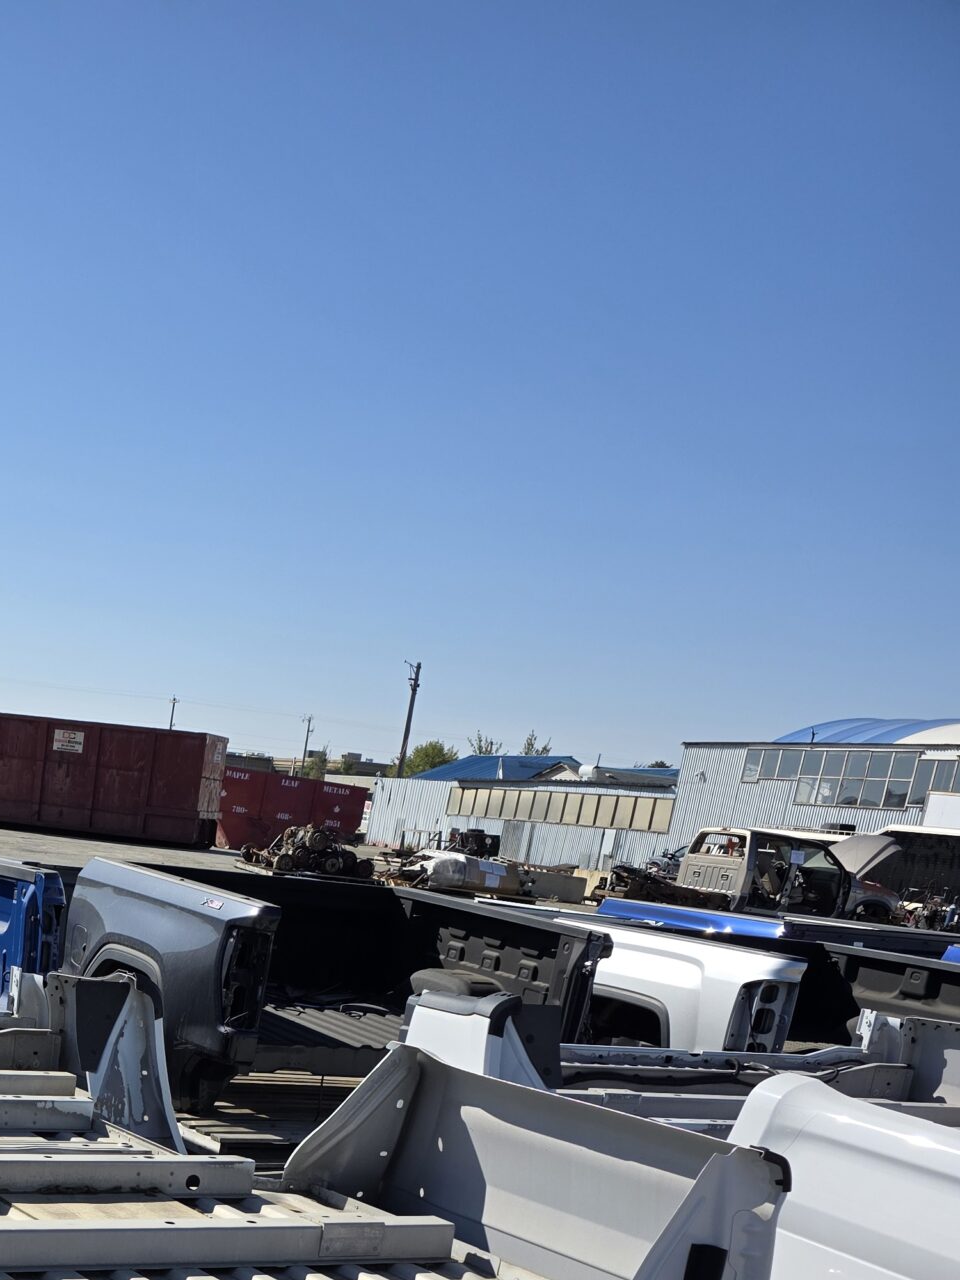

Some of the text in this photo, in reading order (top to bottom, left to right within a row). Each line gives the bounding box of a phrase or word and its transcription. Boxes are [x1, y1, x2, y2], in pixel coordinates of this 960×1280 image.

[226, 770, 350, 795] MAPLE LEAF METALS
